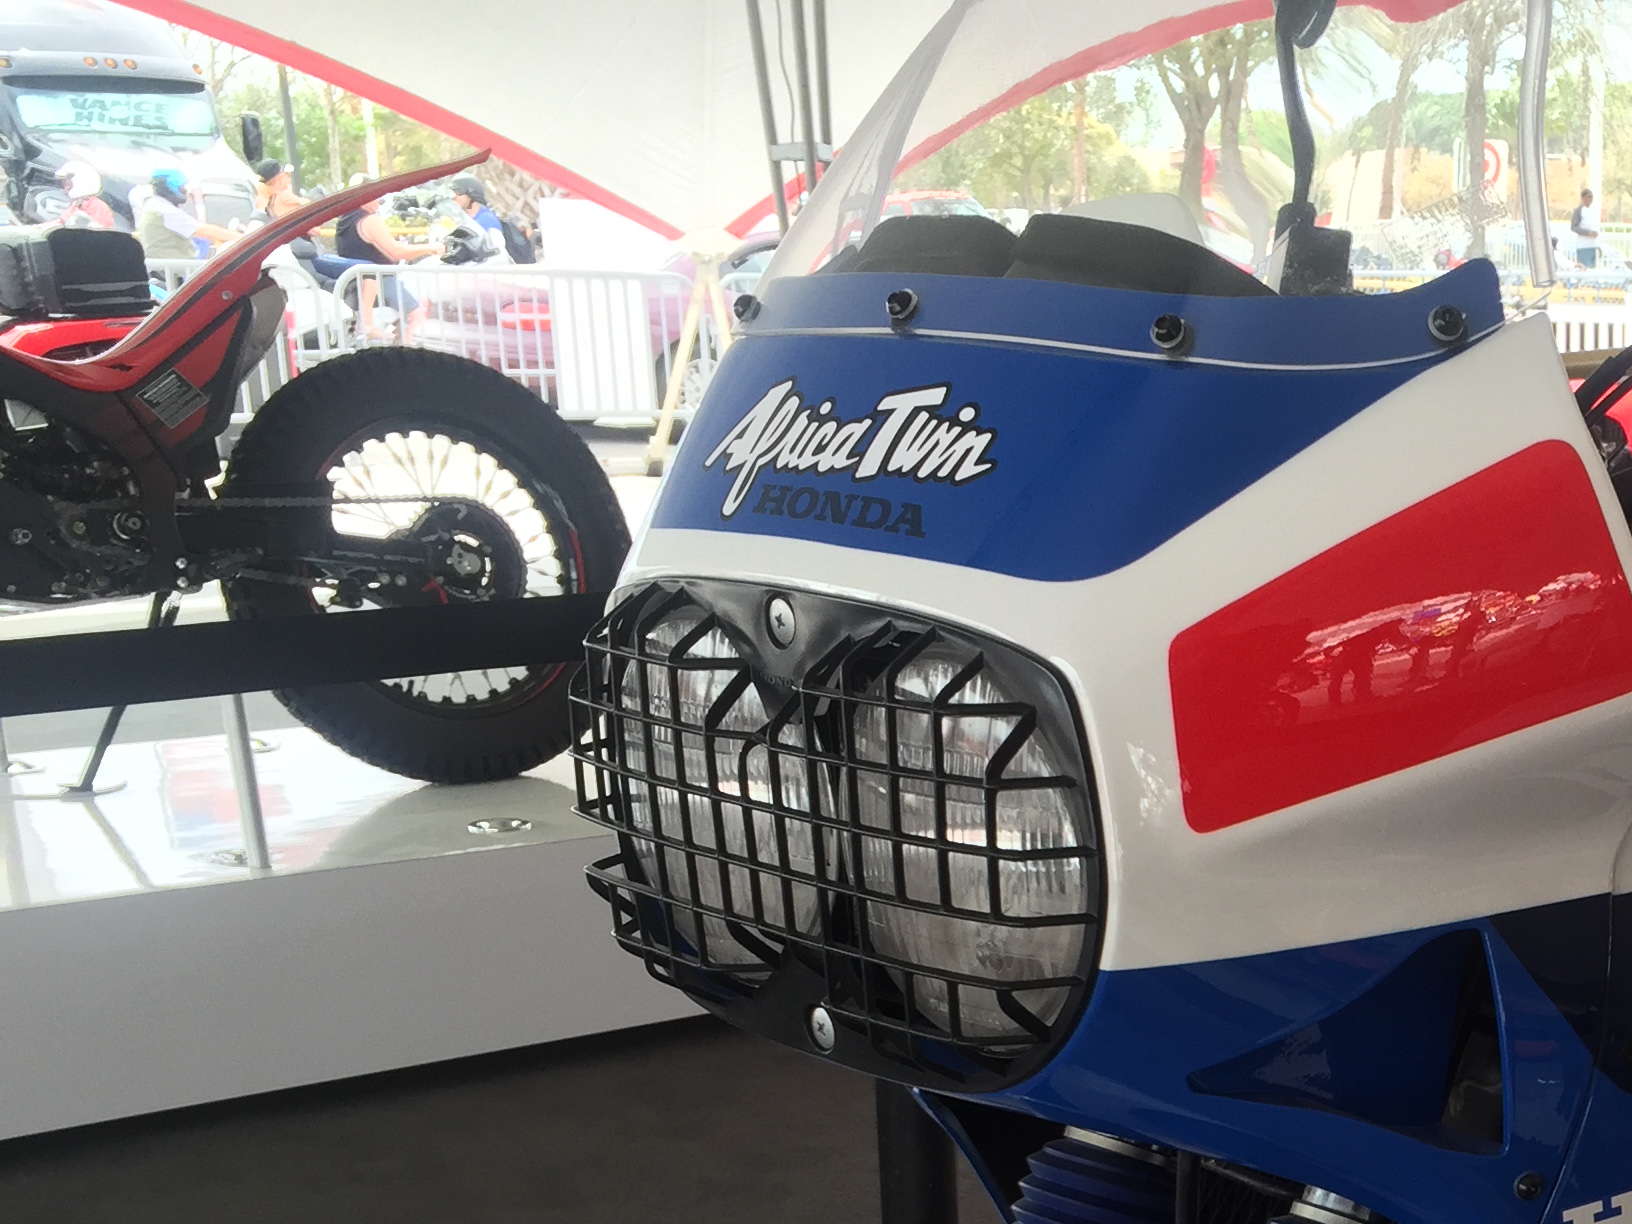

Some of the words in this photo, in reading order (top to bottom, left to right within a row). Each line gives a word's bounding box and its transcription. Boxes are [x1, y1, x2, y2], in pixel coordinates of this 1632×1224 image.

[69, 98, 169, 115] VANCE
[75, 111, 169, 130] HINES
[703, 377, 873, 519] Africa
[854, 385, 995, 483] Twin
[752, 484, 926, 539] HONDA
